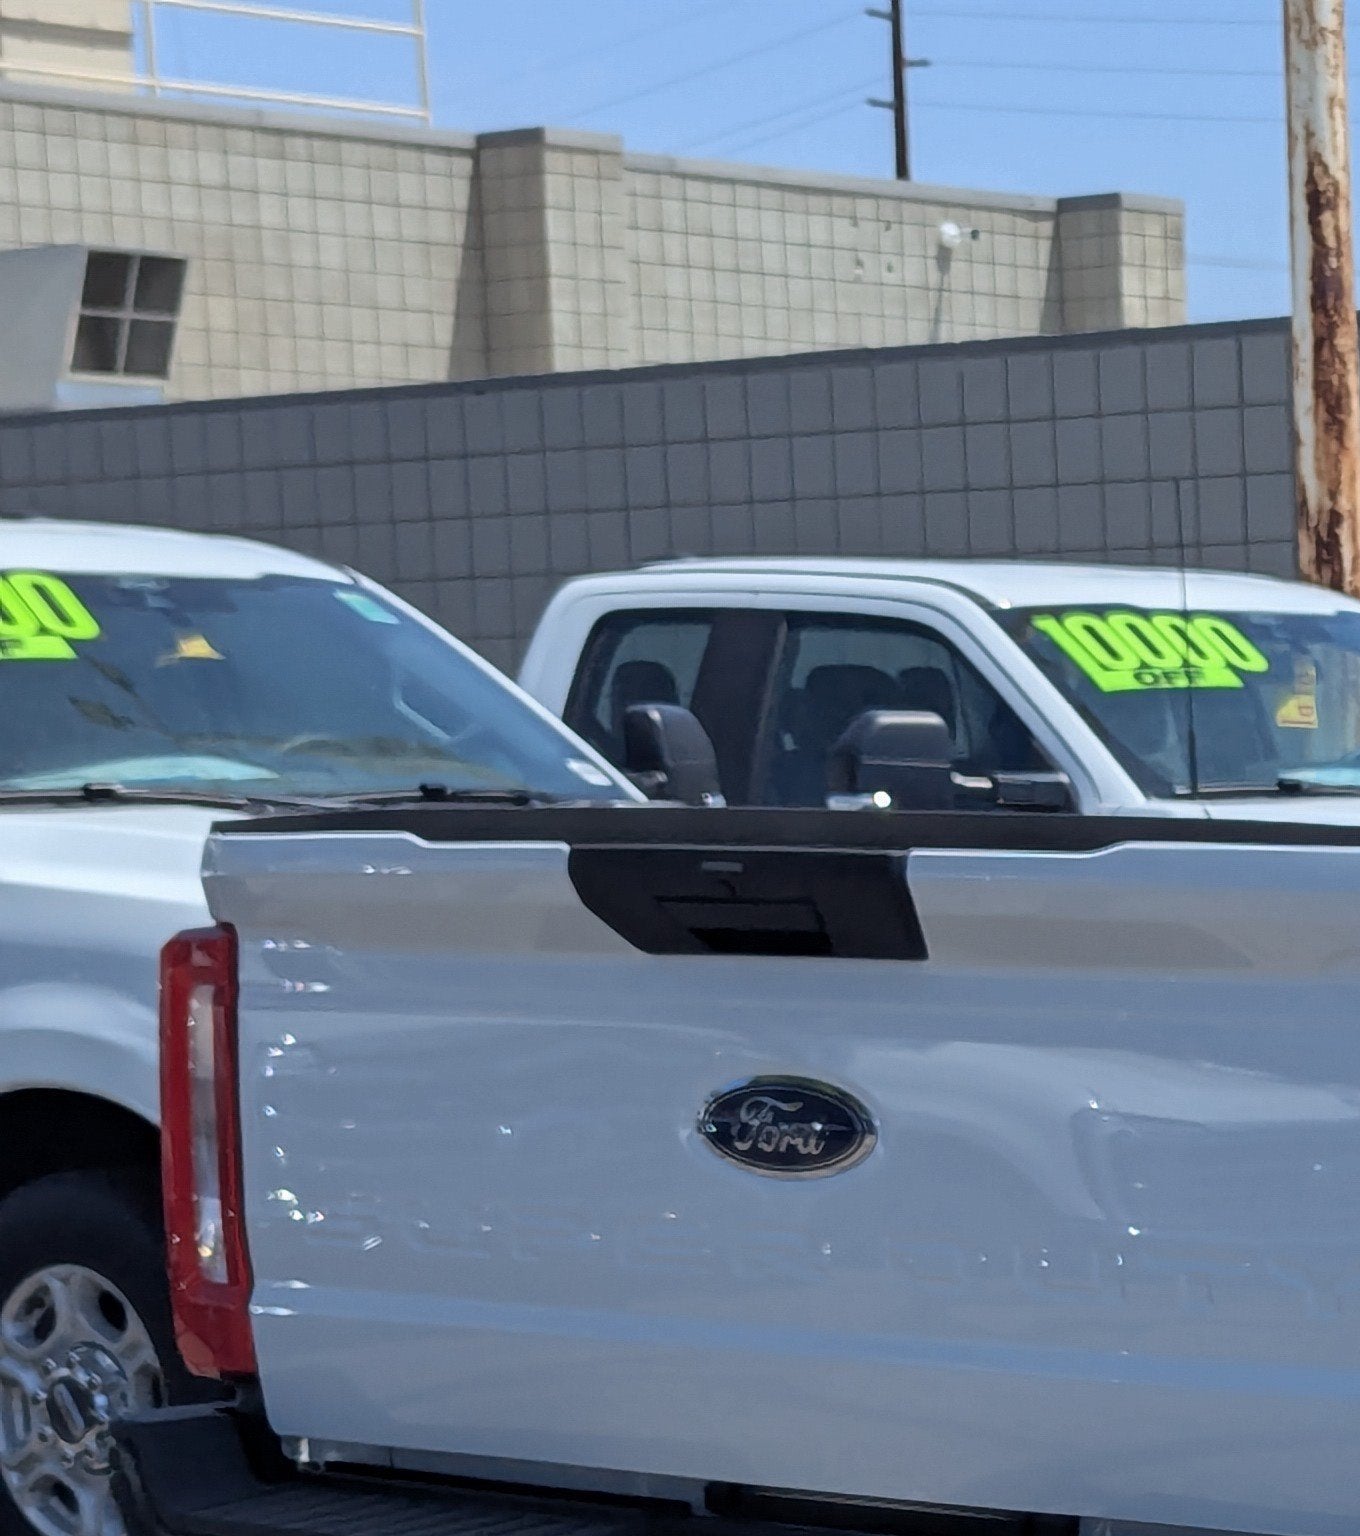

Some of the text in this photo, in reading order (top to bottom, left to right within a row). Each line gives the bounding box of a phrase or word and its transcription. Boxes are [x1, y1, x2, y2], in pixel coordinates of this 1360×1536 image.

[1031, 612, 1269, 673] 10000
[1133, 667, 1205, 686] OFF
[731, 1096, 827, 1156] Ford
